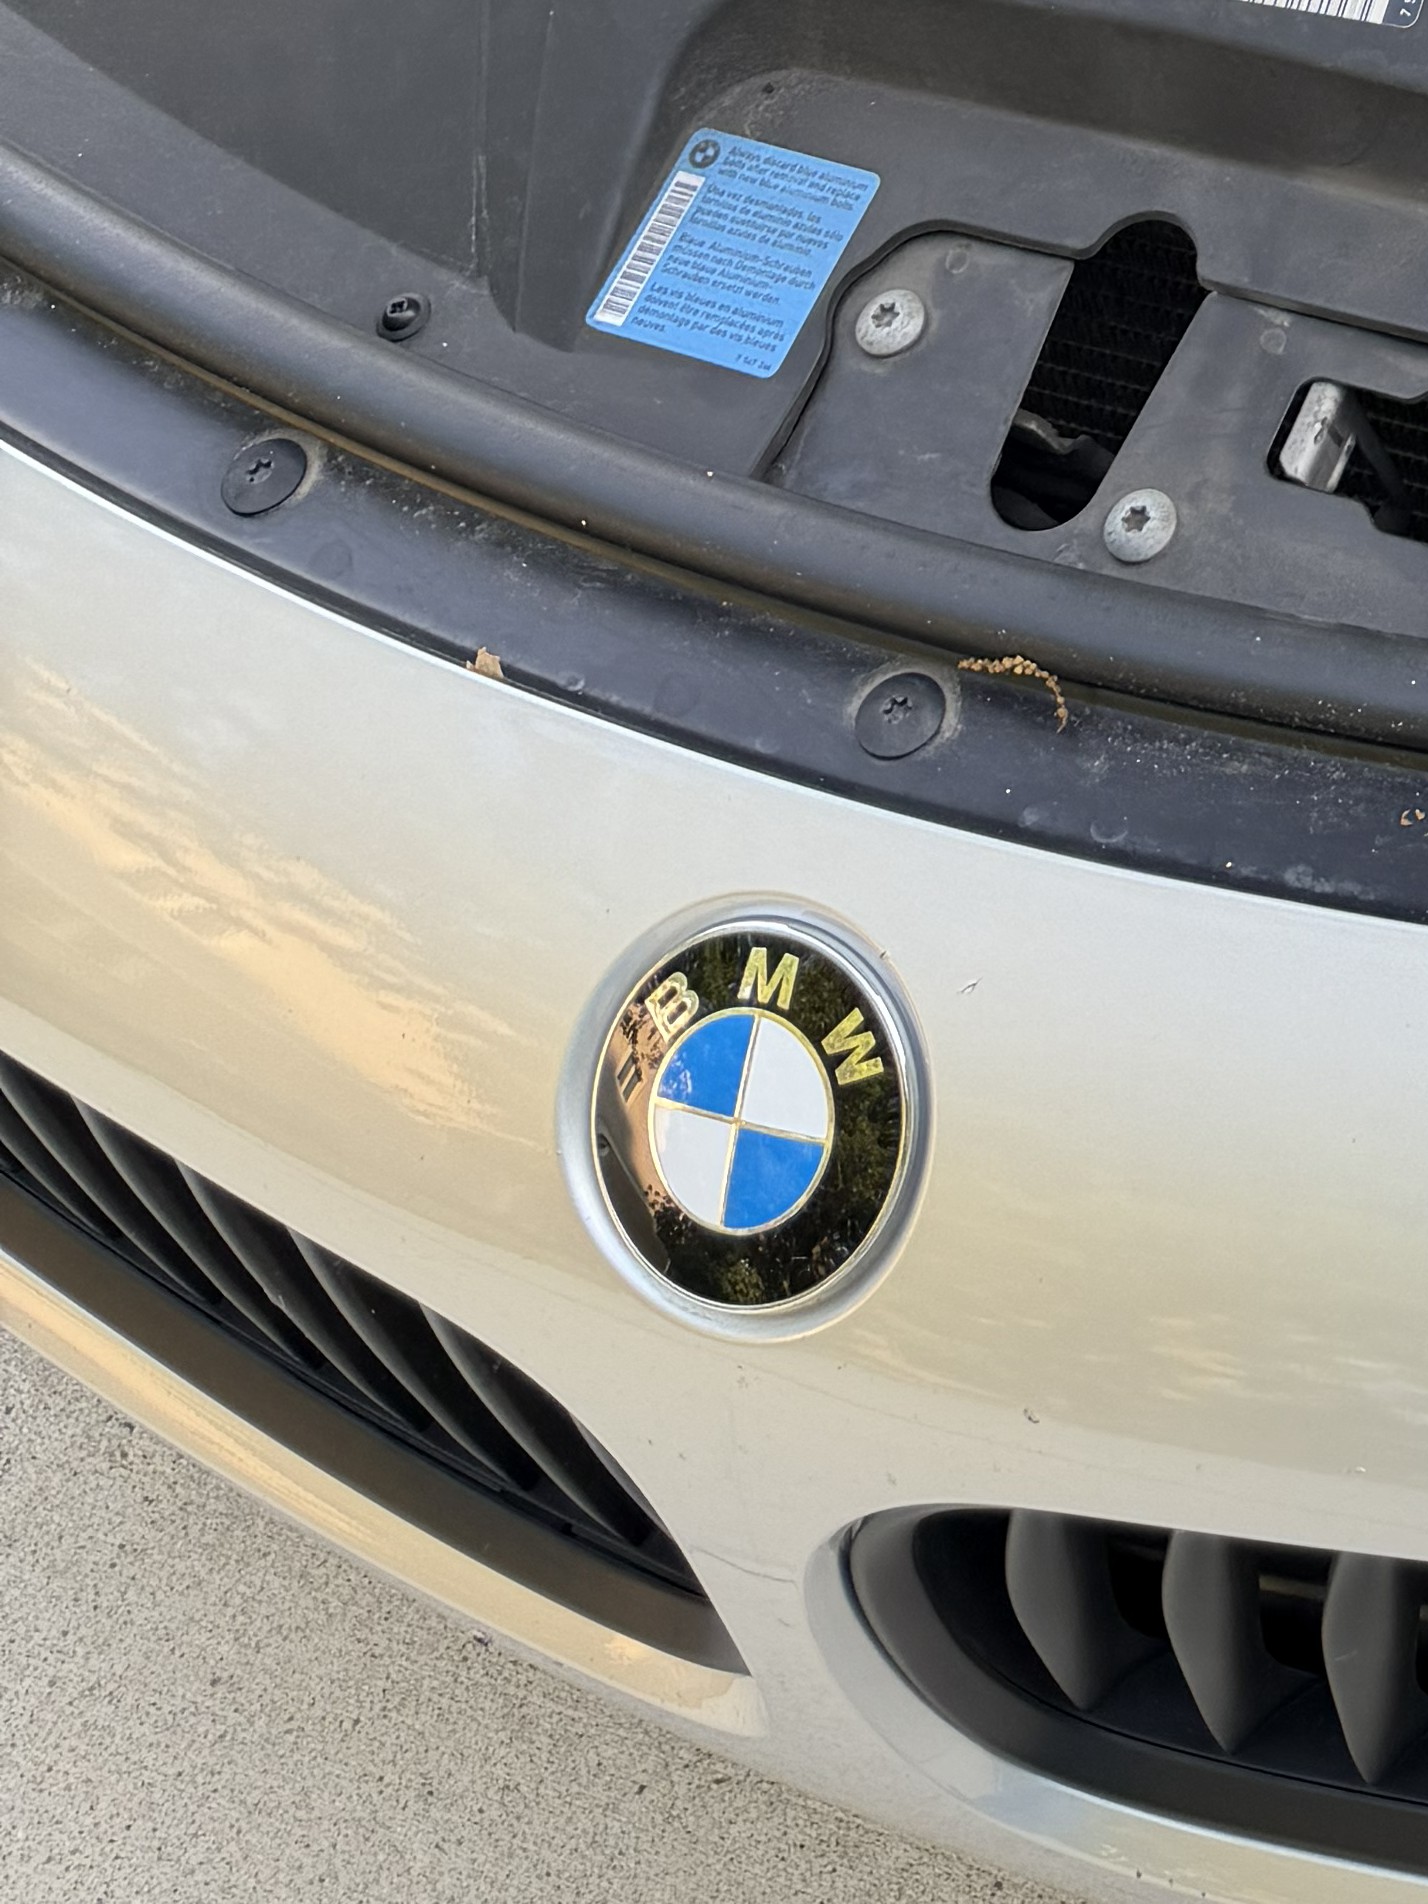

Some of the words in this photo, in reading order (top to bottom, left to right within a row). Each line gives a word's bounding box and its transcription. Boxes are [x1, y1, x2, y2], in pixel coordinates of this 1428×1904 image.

[1400, 8, 1411, 17] 7
[728, 146, 762, 163] Always
[763, 154, 798, 172] discard
[826, 184, 860, 202] replace
[644, 946, 886, 1087] BMW
